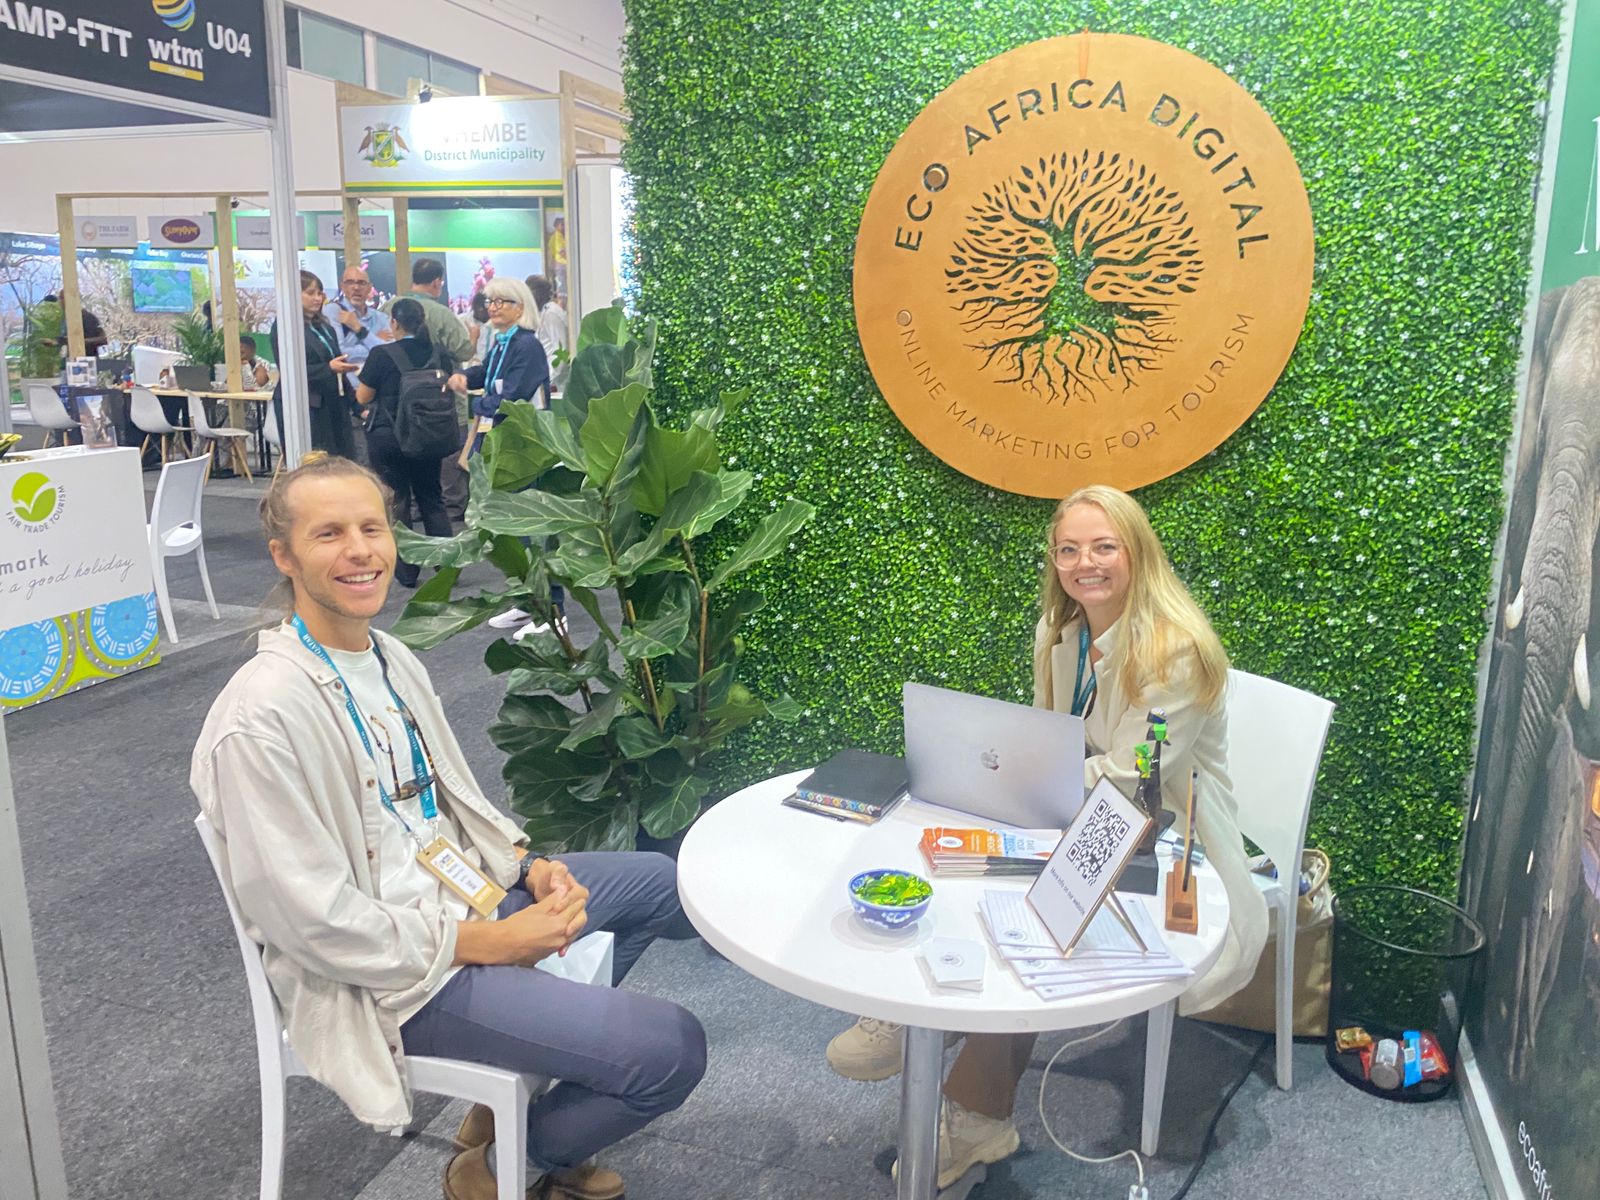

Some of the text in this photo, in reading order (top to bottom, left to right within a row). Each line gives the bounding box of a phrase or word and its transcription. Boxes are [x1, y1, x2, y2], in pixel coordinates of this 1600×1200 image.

[147, 37, 203, 70] wtm
[206, 22, 251, 58] U04
[424, 146, 545, 163] District Municipality
[894, 79, 1270, 260] ECO AFRICA DIGITAL
[333, 223, 375, 236] Kaari
[895, 309, 1255, 460] ONLINE MARKETING FOR TOURISM
[6, 485, 67, 534] FAIR TRADE TOURISM
[26, 564, 70, 601] good
[74, 554, 134, 583] holiday
